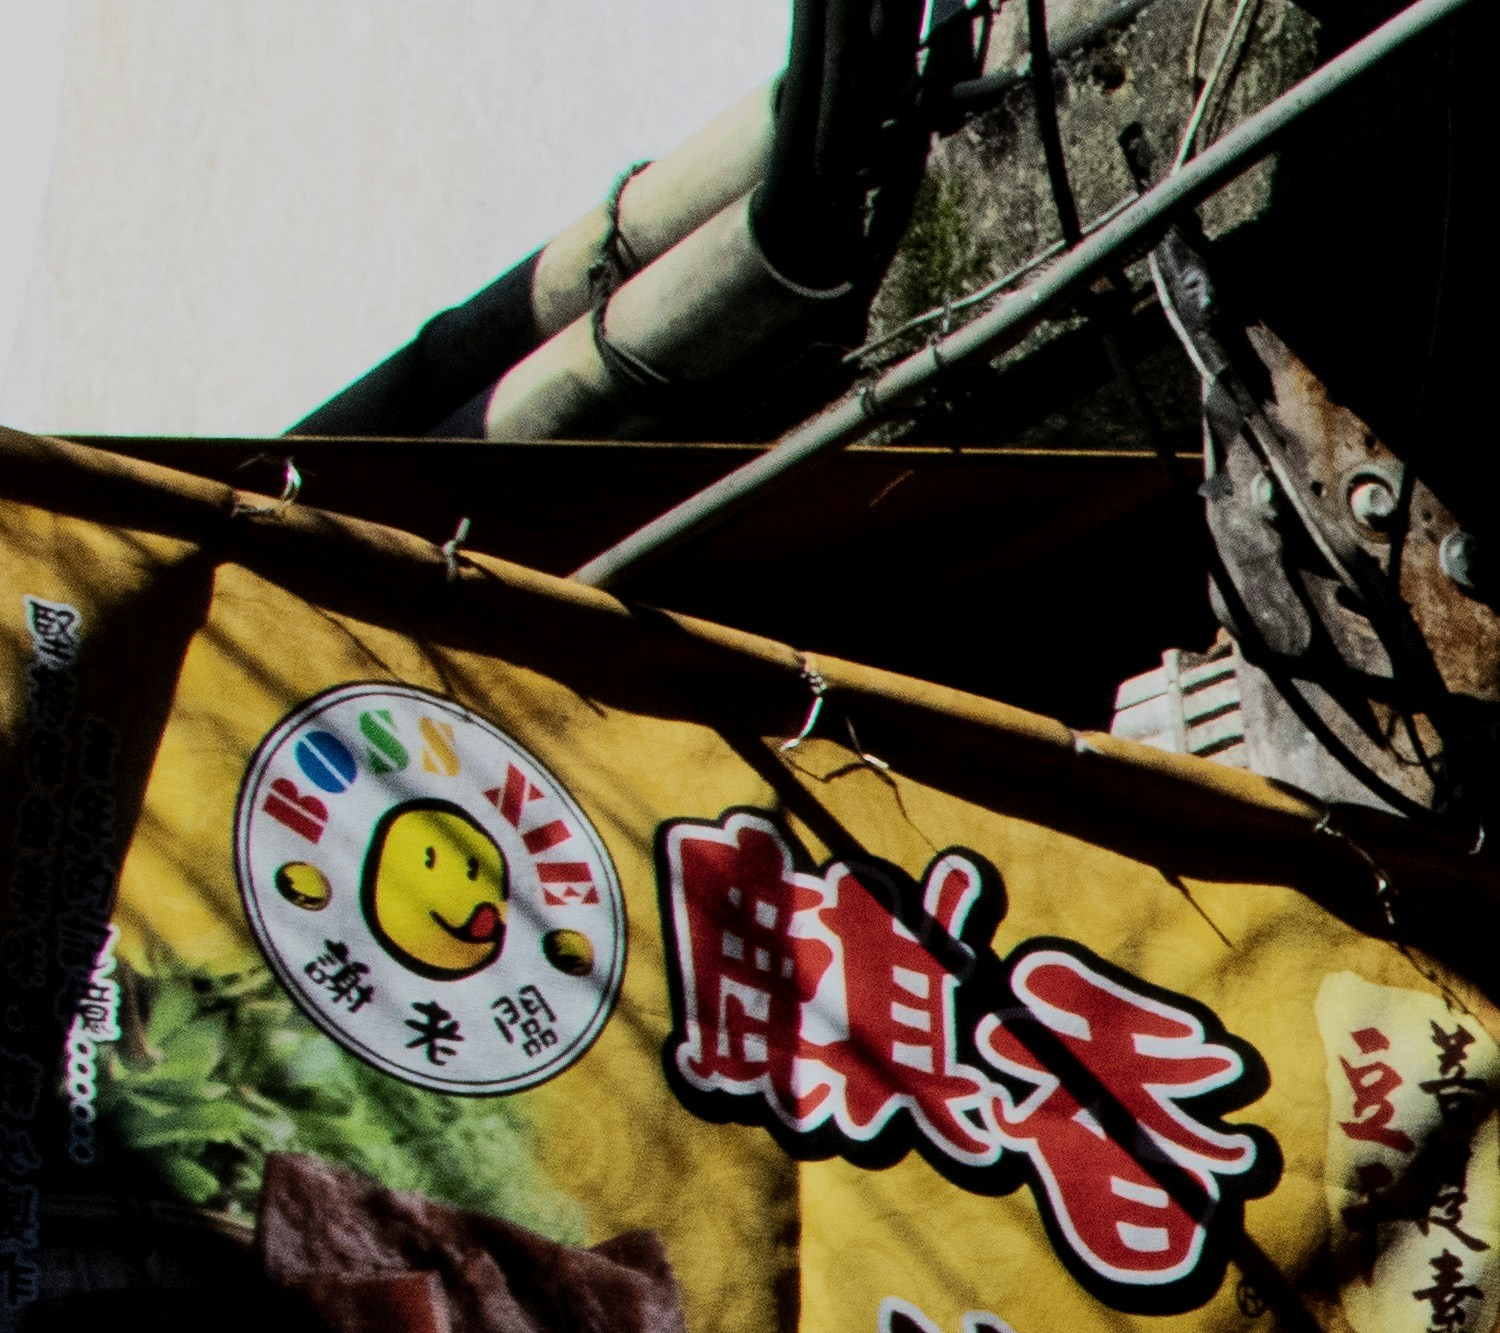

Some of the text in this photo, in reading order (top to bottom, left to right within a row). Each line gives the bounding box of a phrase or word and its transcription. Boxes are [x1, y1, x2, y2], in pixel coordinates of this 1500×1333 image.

[262, 708, 600, 906] BOSS XIE
[303, 938, 558, 1067] 謝老闆
